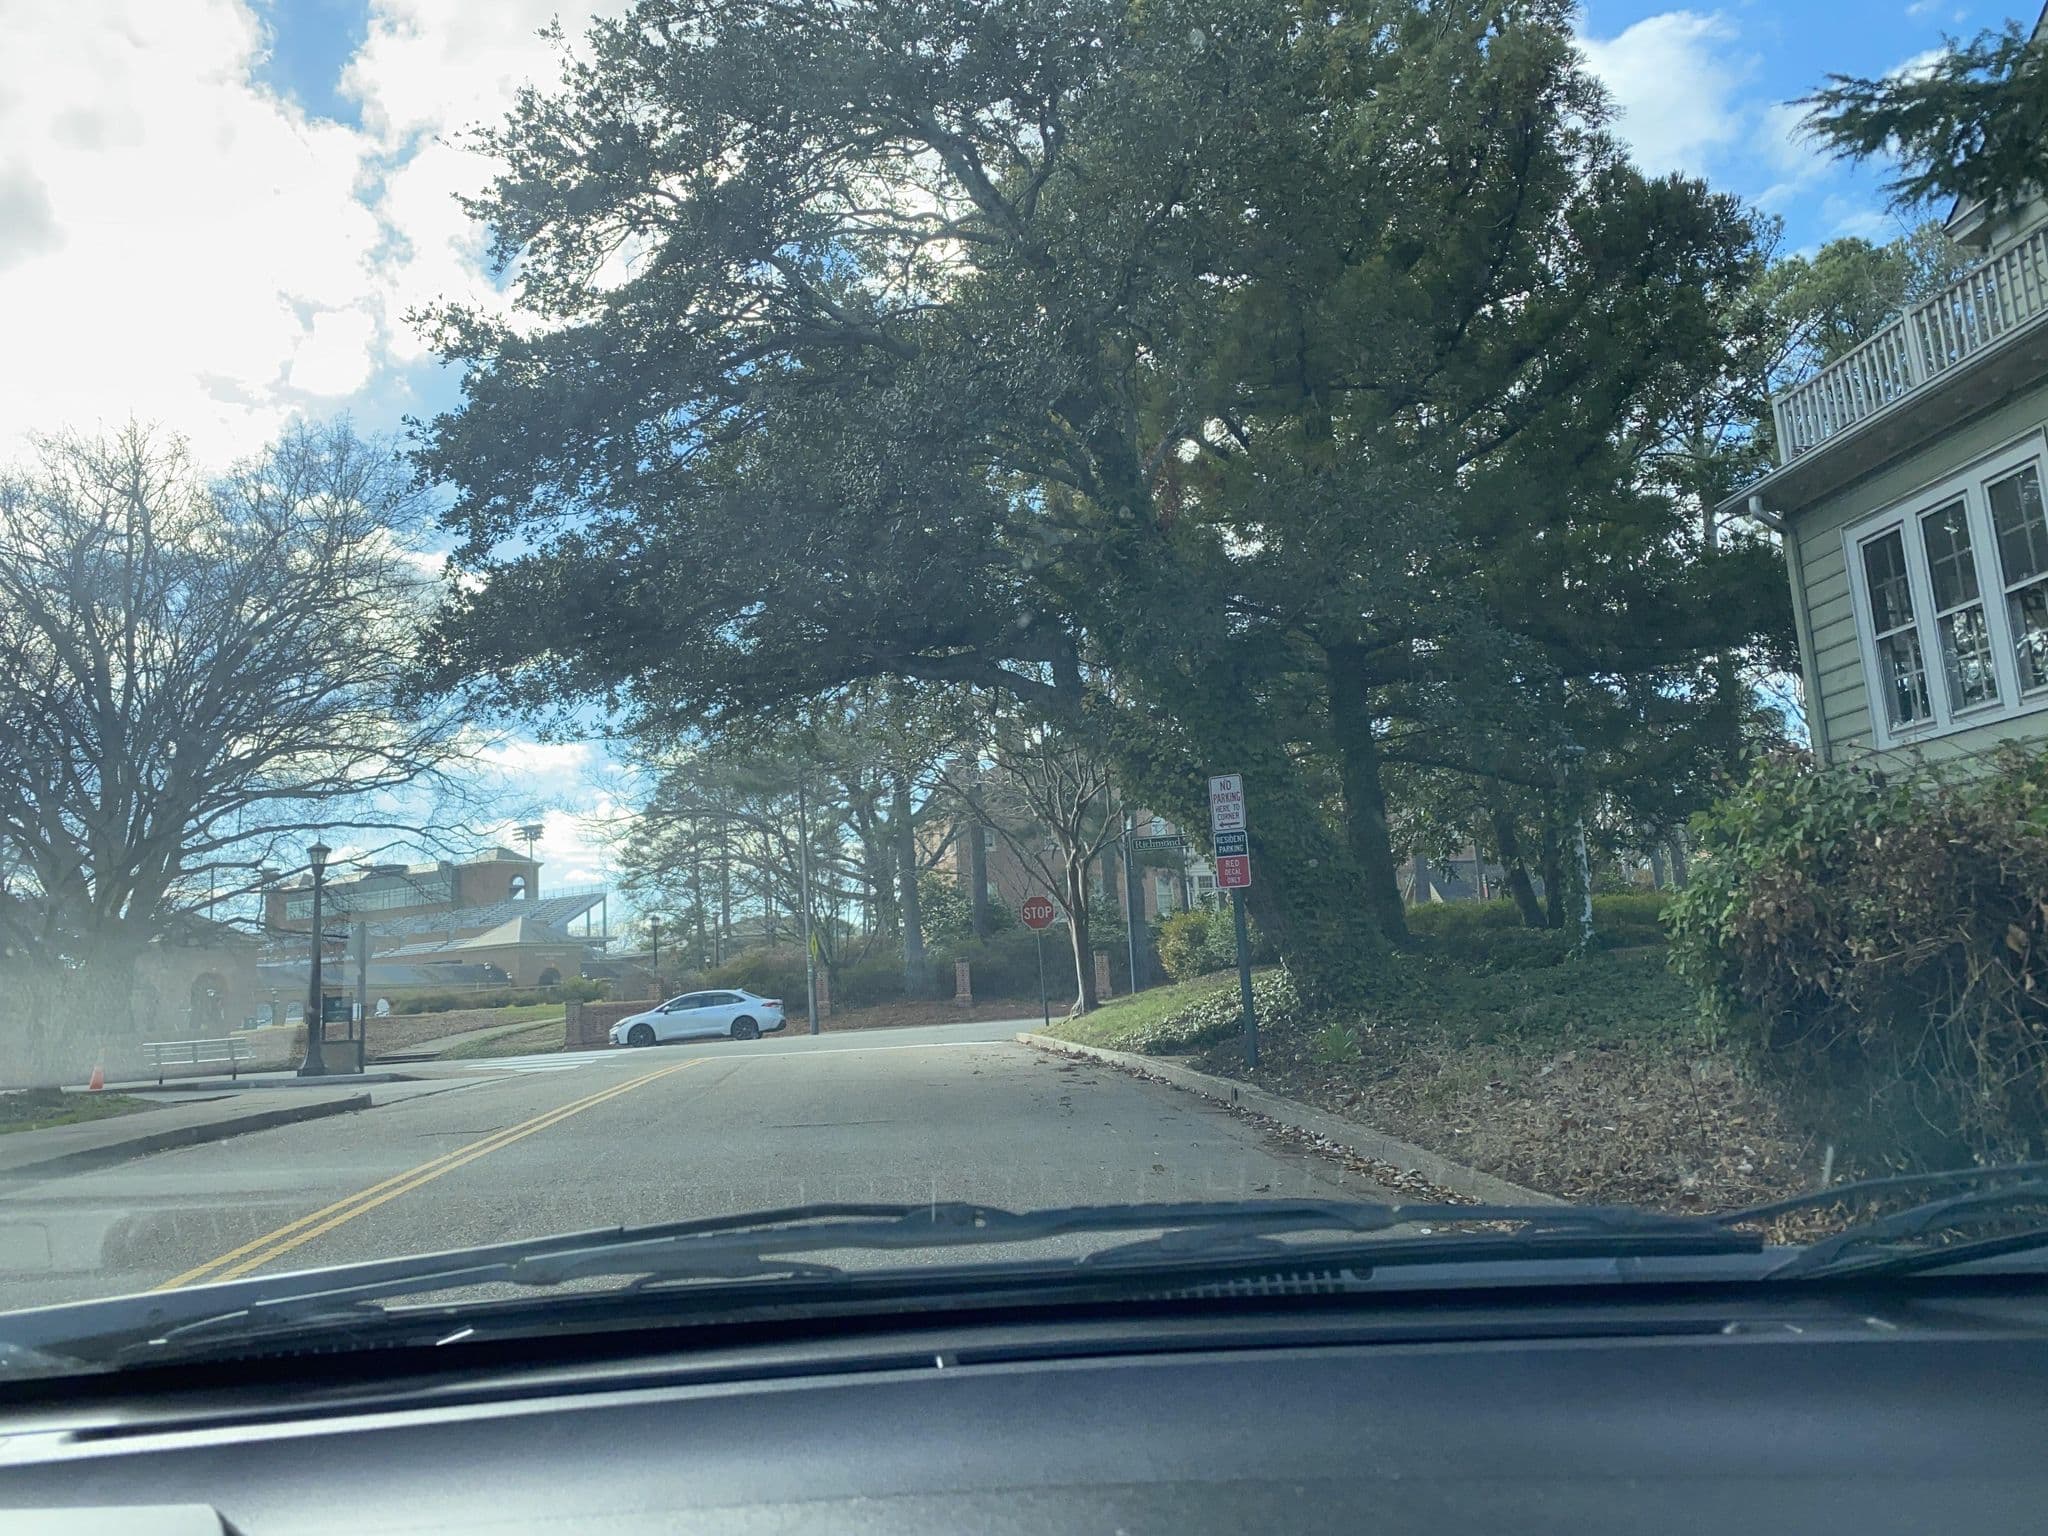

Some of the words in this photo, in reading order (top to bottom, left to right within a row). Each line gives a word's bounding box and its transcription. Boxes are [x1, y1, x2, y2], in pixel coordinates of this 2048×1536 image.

[1220, 780, 1232, 791] NO
[1213, 791, 1241, 804] PARKING
[1215, 804, 1230, 813] HERE
[1233, 803, 1241, 811] TO
[1217, 811, 1240, 821] CORNER
[1135, 836, 1181, 849] Richmond
[1216, 834, 1245, 844] RESIDENT
[1218, 845, 1244, 853] PARKING
[1225, 859, 1240, 868] RED
[1225, 868, 1242, 876] DECAL
[1226, 876, 1241, 884] ONLY
[1024, 905, 1052, 920] STOP
